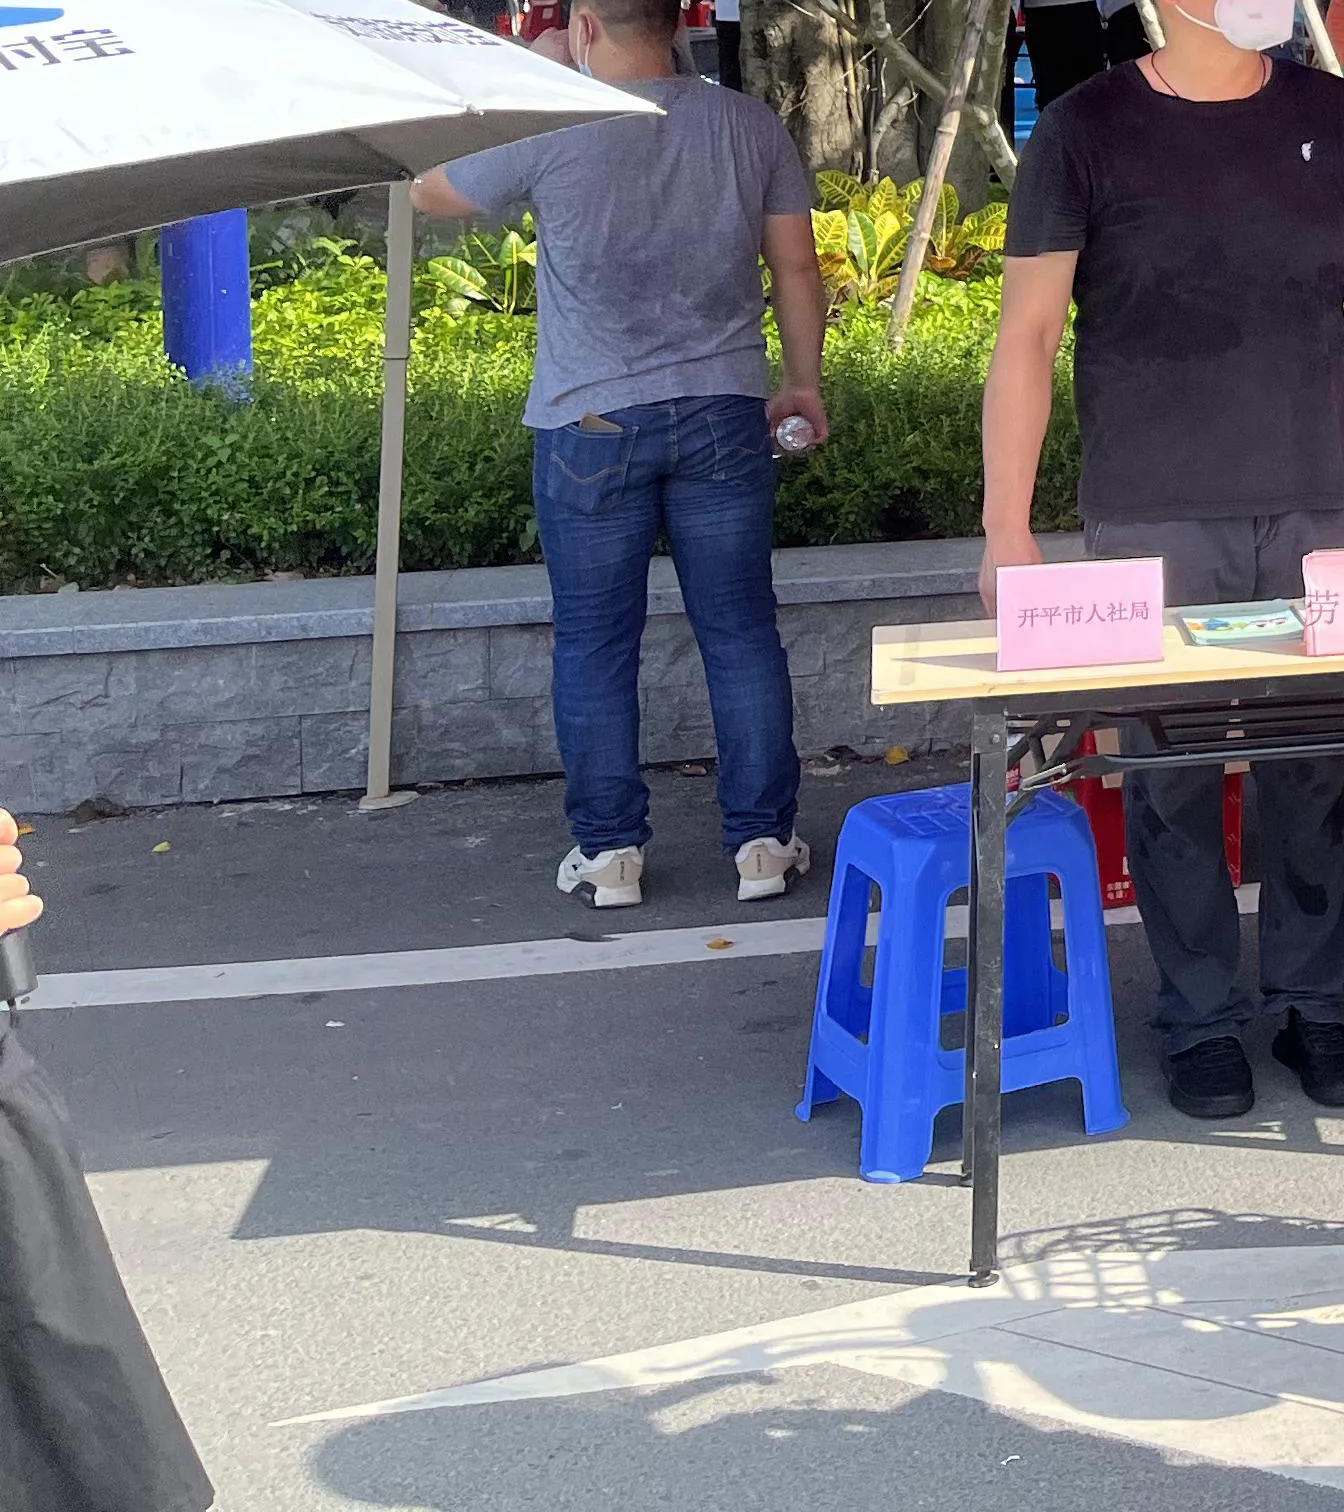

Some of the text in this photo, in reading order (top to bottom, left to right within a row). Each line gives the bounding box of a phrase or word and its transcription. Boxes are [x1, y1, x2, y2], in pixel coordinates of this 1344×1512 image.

[1017, 600, 1150, 629] 开平市人社局
